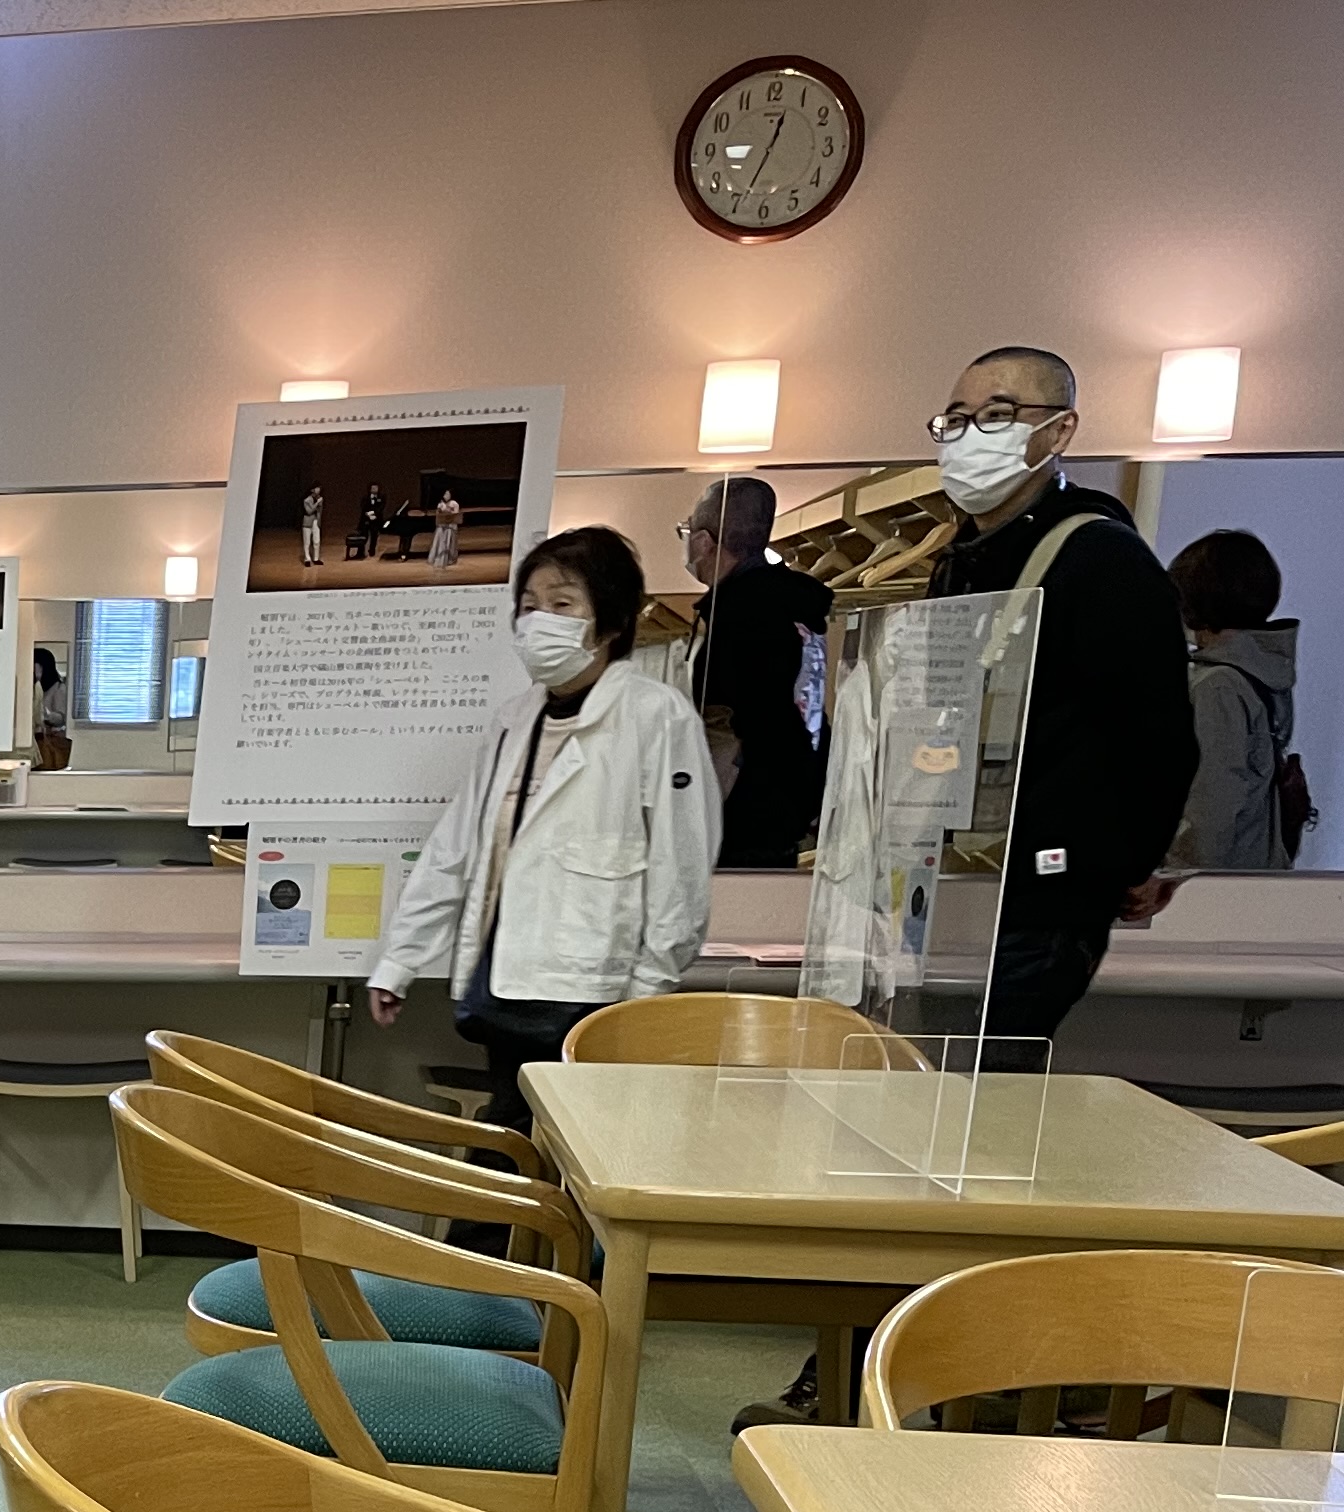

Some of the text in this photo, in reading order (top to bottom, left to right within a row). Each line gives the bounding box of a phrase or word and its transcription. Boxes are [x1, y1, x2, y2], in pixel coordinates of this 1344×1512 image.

[738, 89, 752, 111] 11
[766, 80, 783, 102] 12
[799, 86, 807, 108] 1
[713, 111, 730, 134] 10
[817, 105, 830, 127] 2
[704, 142, 716, 165] 9
[821, 136, 834, 158] 3
[709, 171, 721, 194] 8
[809, 166, 822, 188] 4
[731, 192, 742, 214] 7
[758, 200, 769, 220] 6
[787, 189, 799, 212] 5
